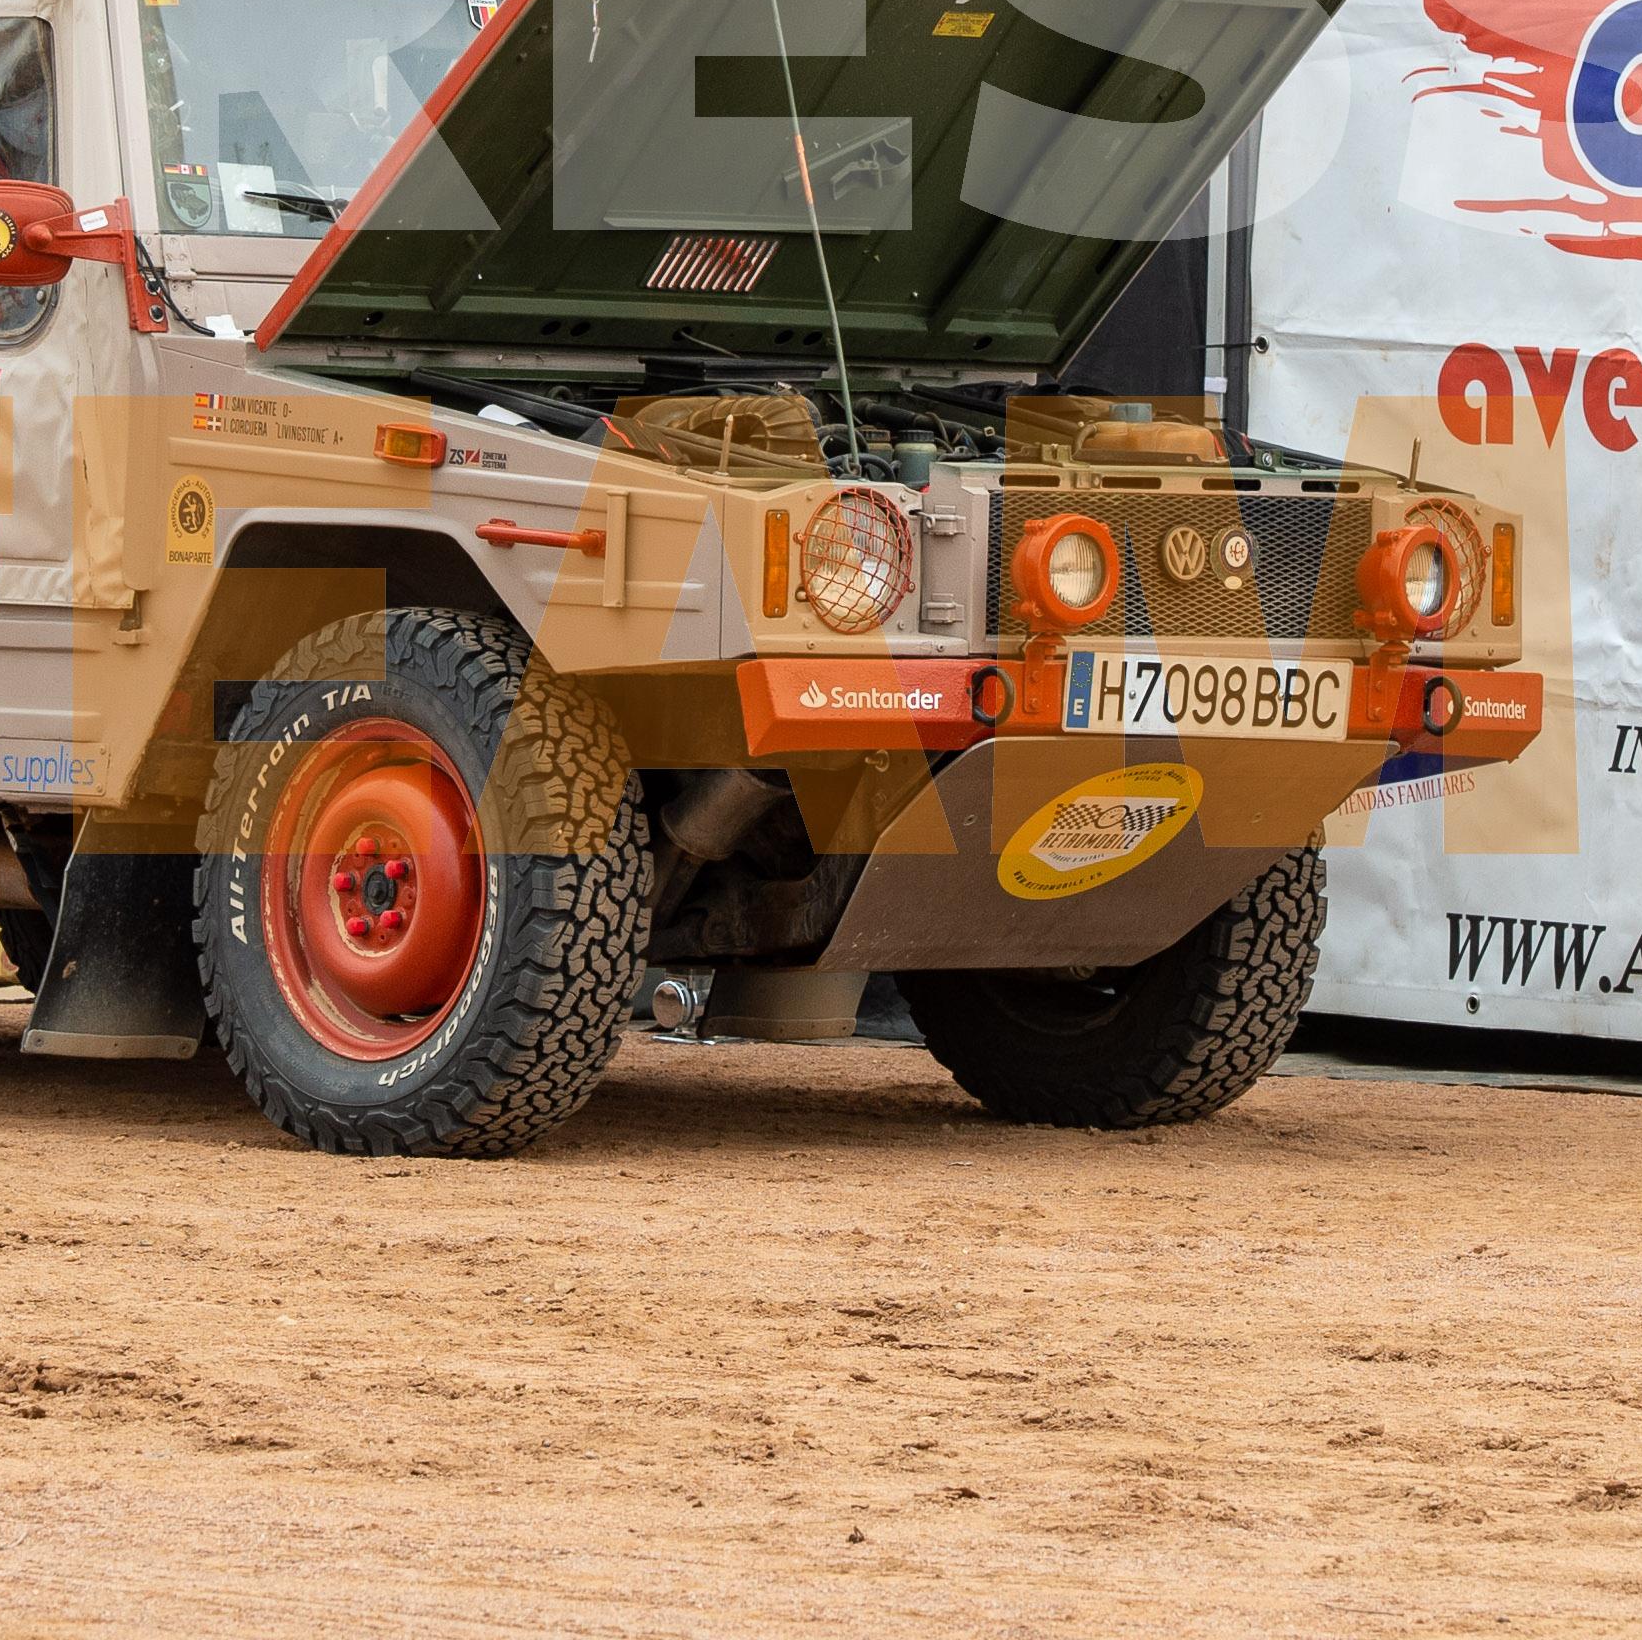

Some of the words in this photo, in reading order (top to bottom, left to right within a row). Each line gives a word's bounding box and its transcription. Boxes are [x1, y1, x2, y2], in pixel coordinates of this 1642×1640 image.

[232, 397, 246, 412] SAN
[247, 398, 277, 416] VICENTE
[230, 418, 267, 437] CORCUERA
[169, 550, 212, 563] BONAPARTE
[322, 684, 372, 711] T/A
[831, 682, 943, 711] Santander
[1072, 700, 1085, 717] E
[1463, 694, 1527, 720] Santander
[2, 745, 96, 791] supplies
[1397, 772, 1476, 805] FAMILIARES
[231, 712, 310, 945] All-Terrain
[1039, 832, 1140, 850] RETROMOBILE
[379, 863, 498, 1088] BFGoodrich
